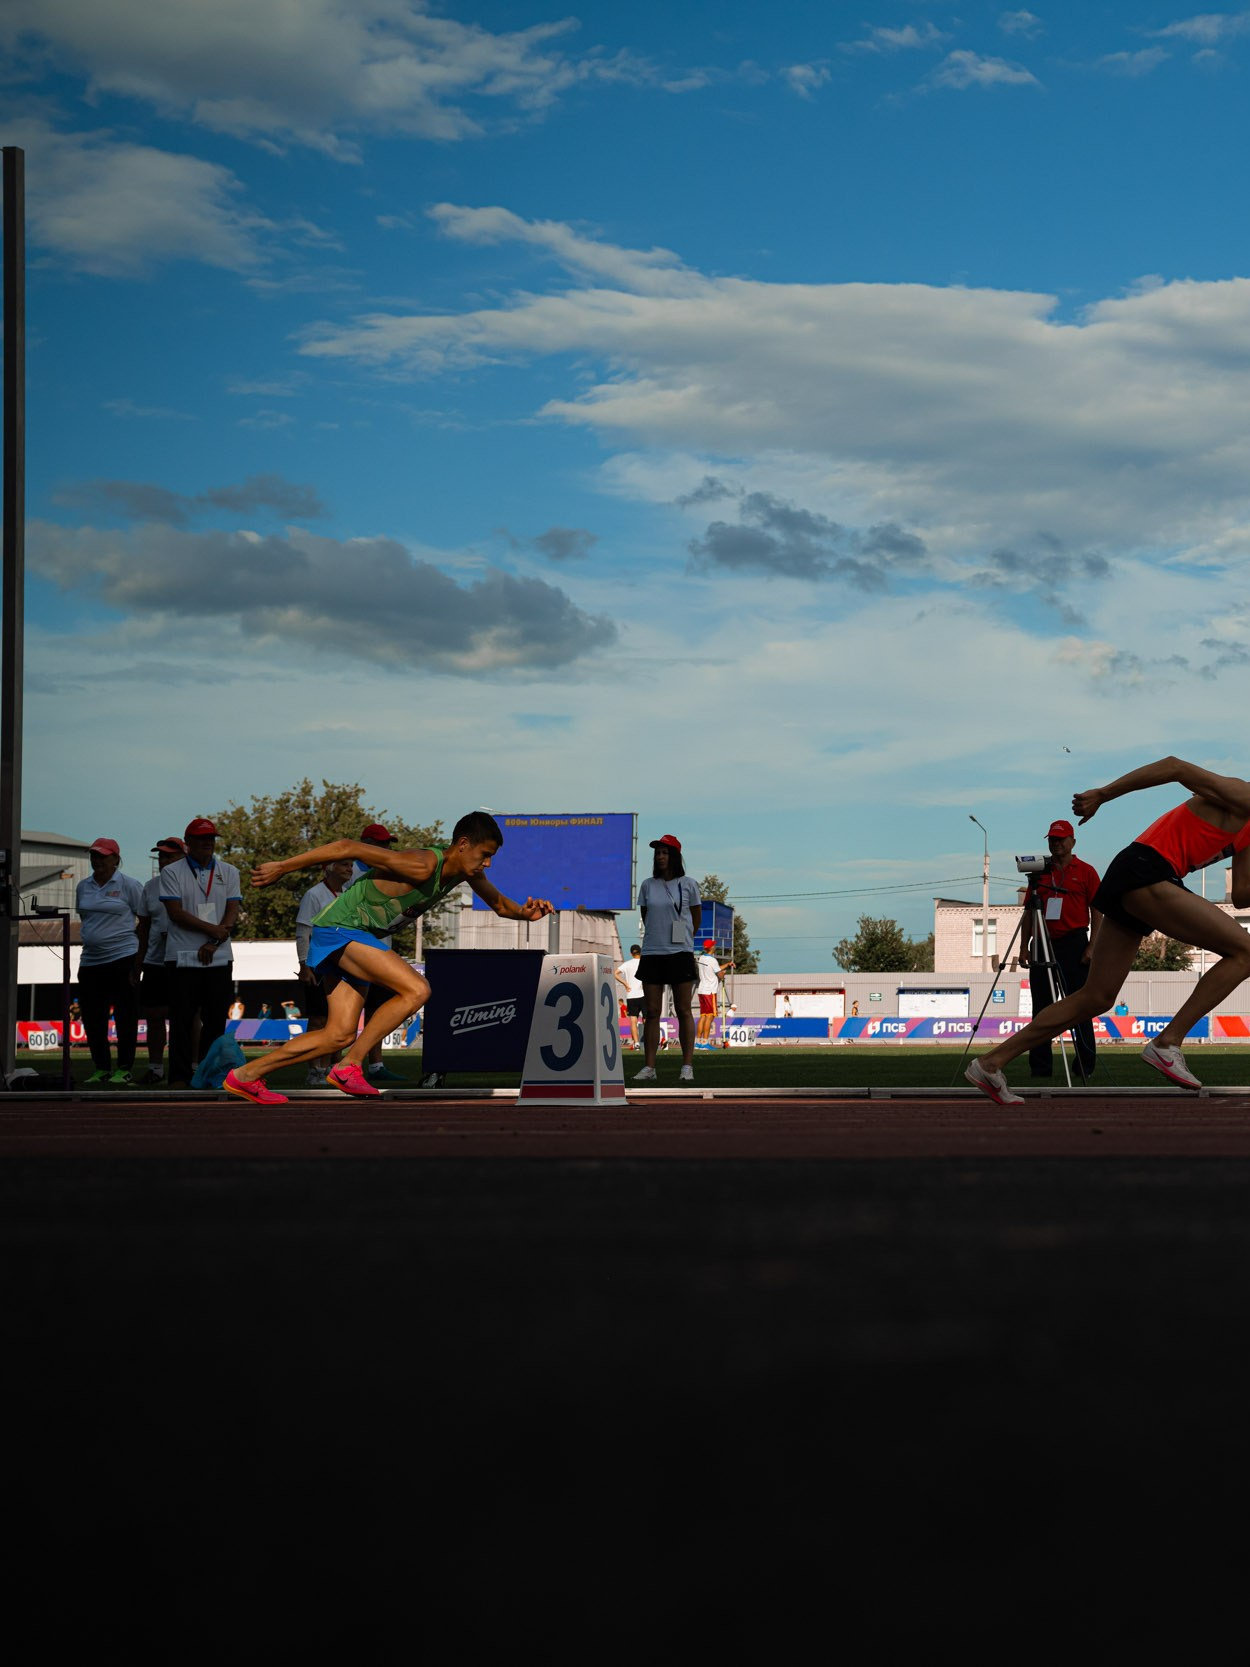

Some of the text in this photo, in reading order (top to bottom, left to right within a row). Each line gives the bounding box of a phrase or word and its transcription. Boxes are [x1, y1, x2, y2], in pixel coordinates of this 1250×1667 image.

[570, 817, 604, 826] ФИНАЛ
[560, 965, 586, 975] polanik
[449, 998, 517, 1028] eTiming
[540, 982, 584, 1071] 3
[601, 982, 617, 1071] 3
[882, 1022, 906, 1033] ПСБ
[949, 1022, 972, 1033] ПСБ
[29, 1034, 43, 1046] 60
[731, 1030, 747, 1042] 40
